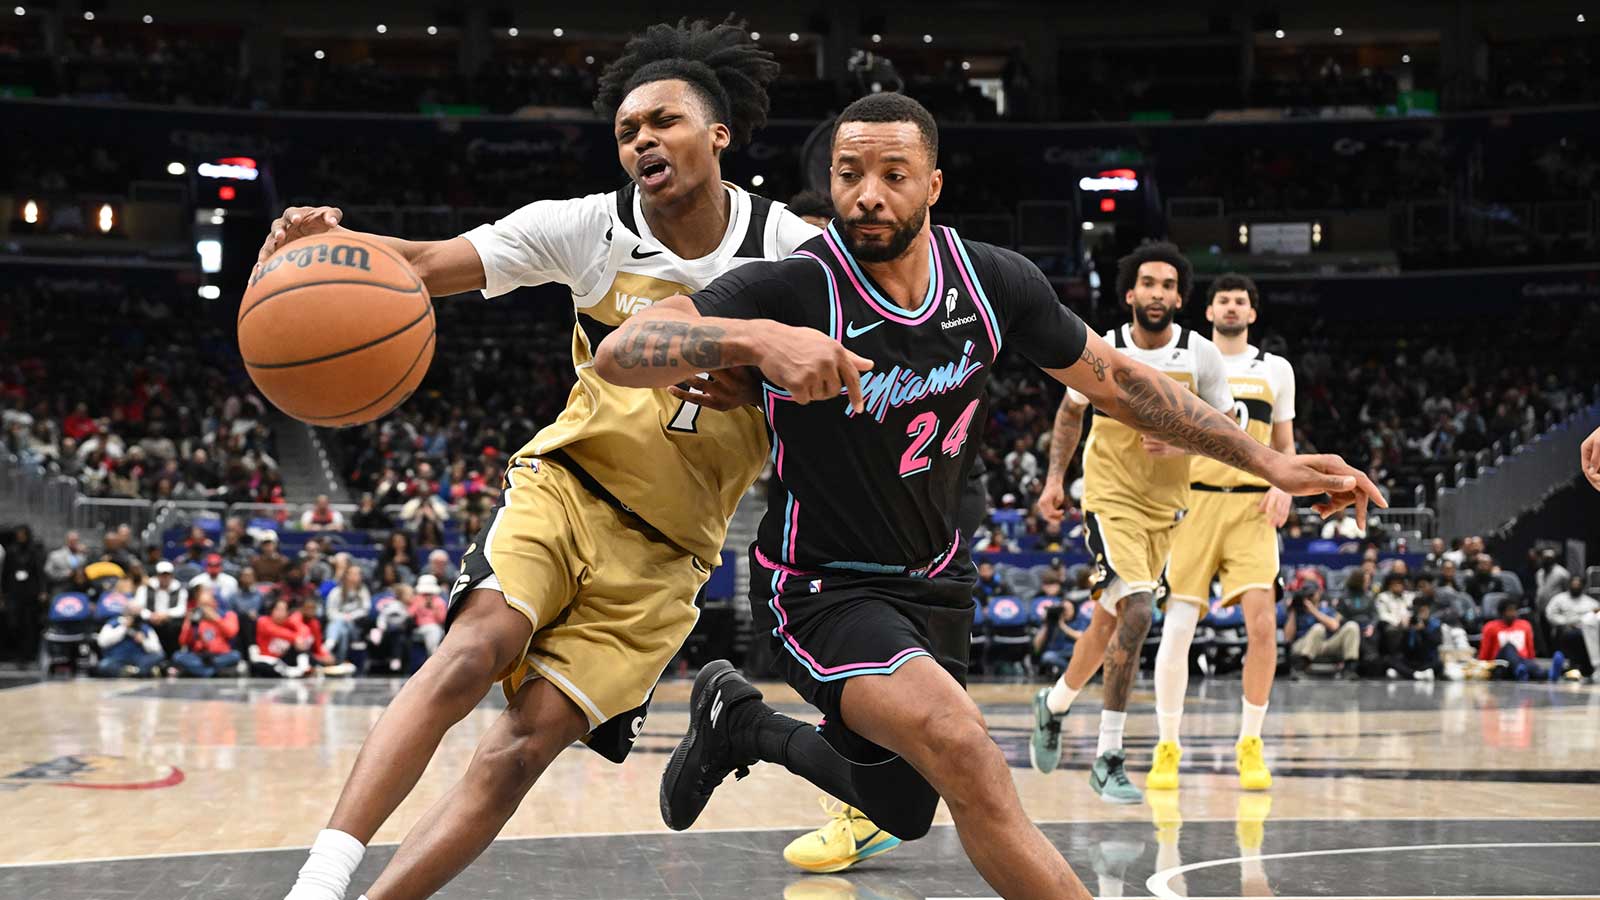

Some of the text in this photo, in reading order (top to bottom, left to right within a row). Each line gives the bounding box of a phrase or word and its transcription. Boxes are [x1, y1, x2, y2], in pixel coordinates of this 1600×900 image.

[941, 313, 977, 330] Robinhood
[845, 340, 983, 423] Miami
[899, 398, 980, 478] 24
